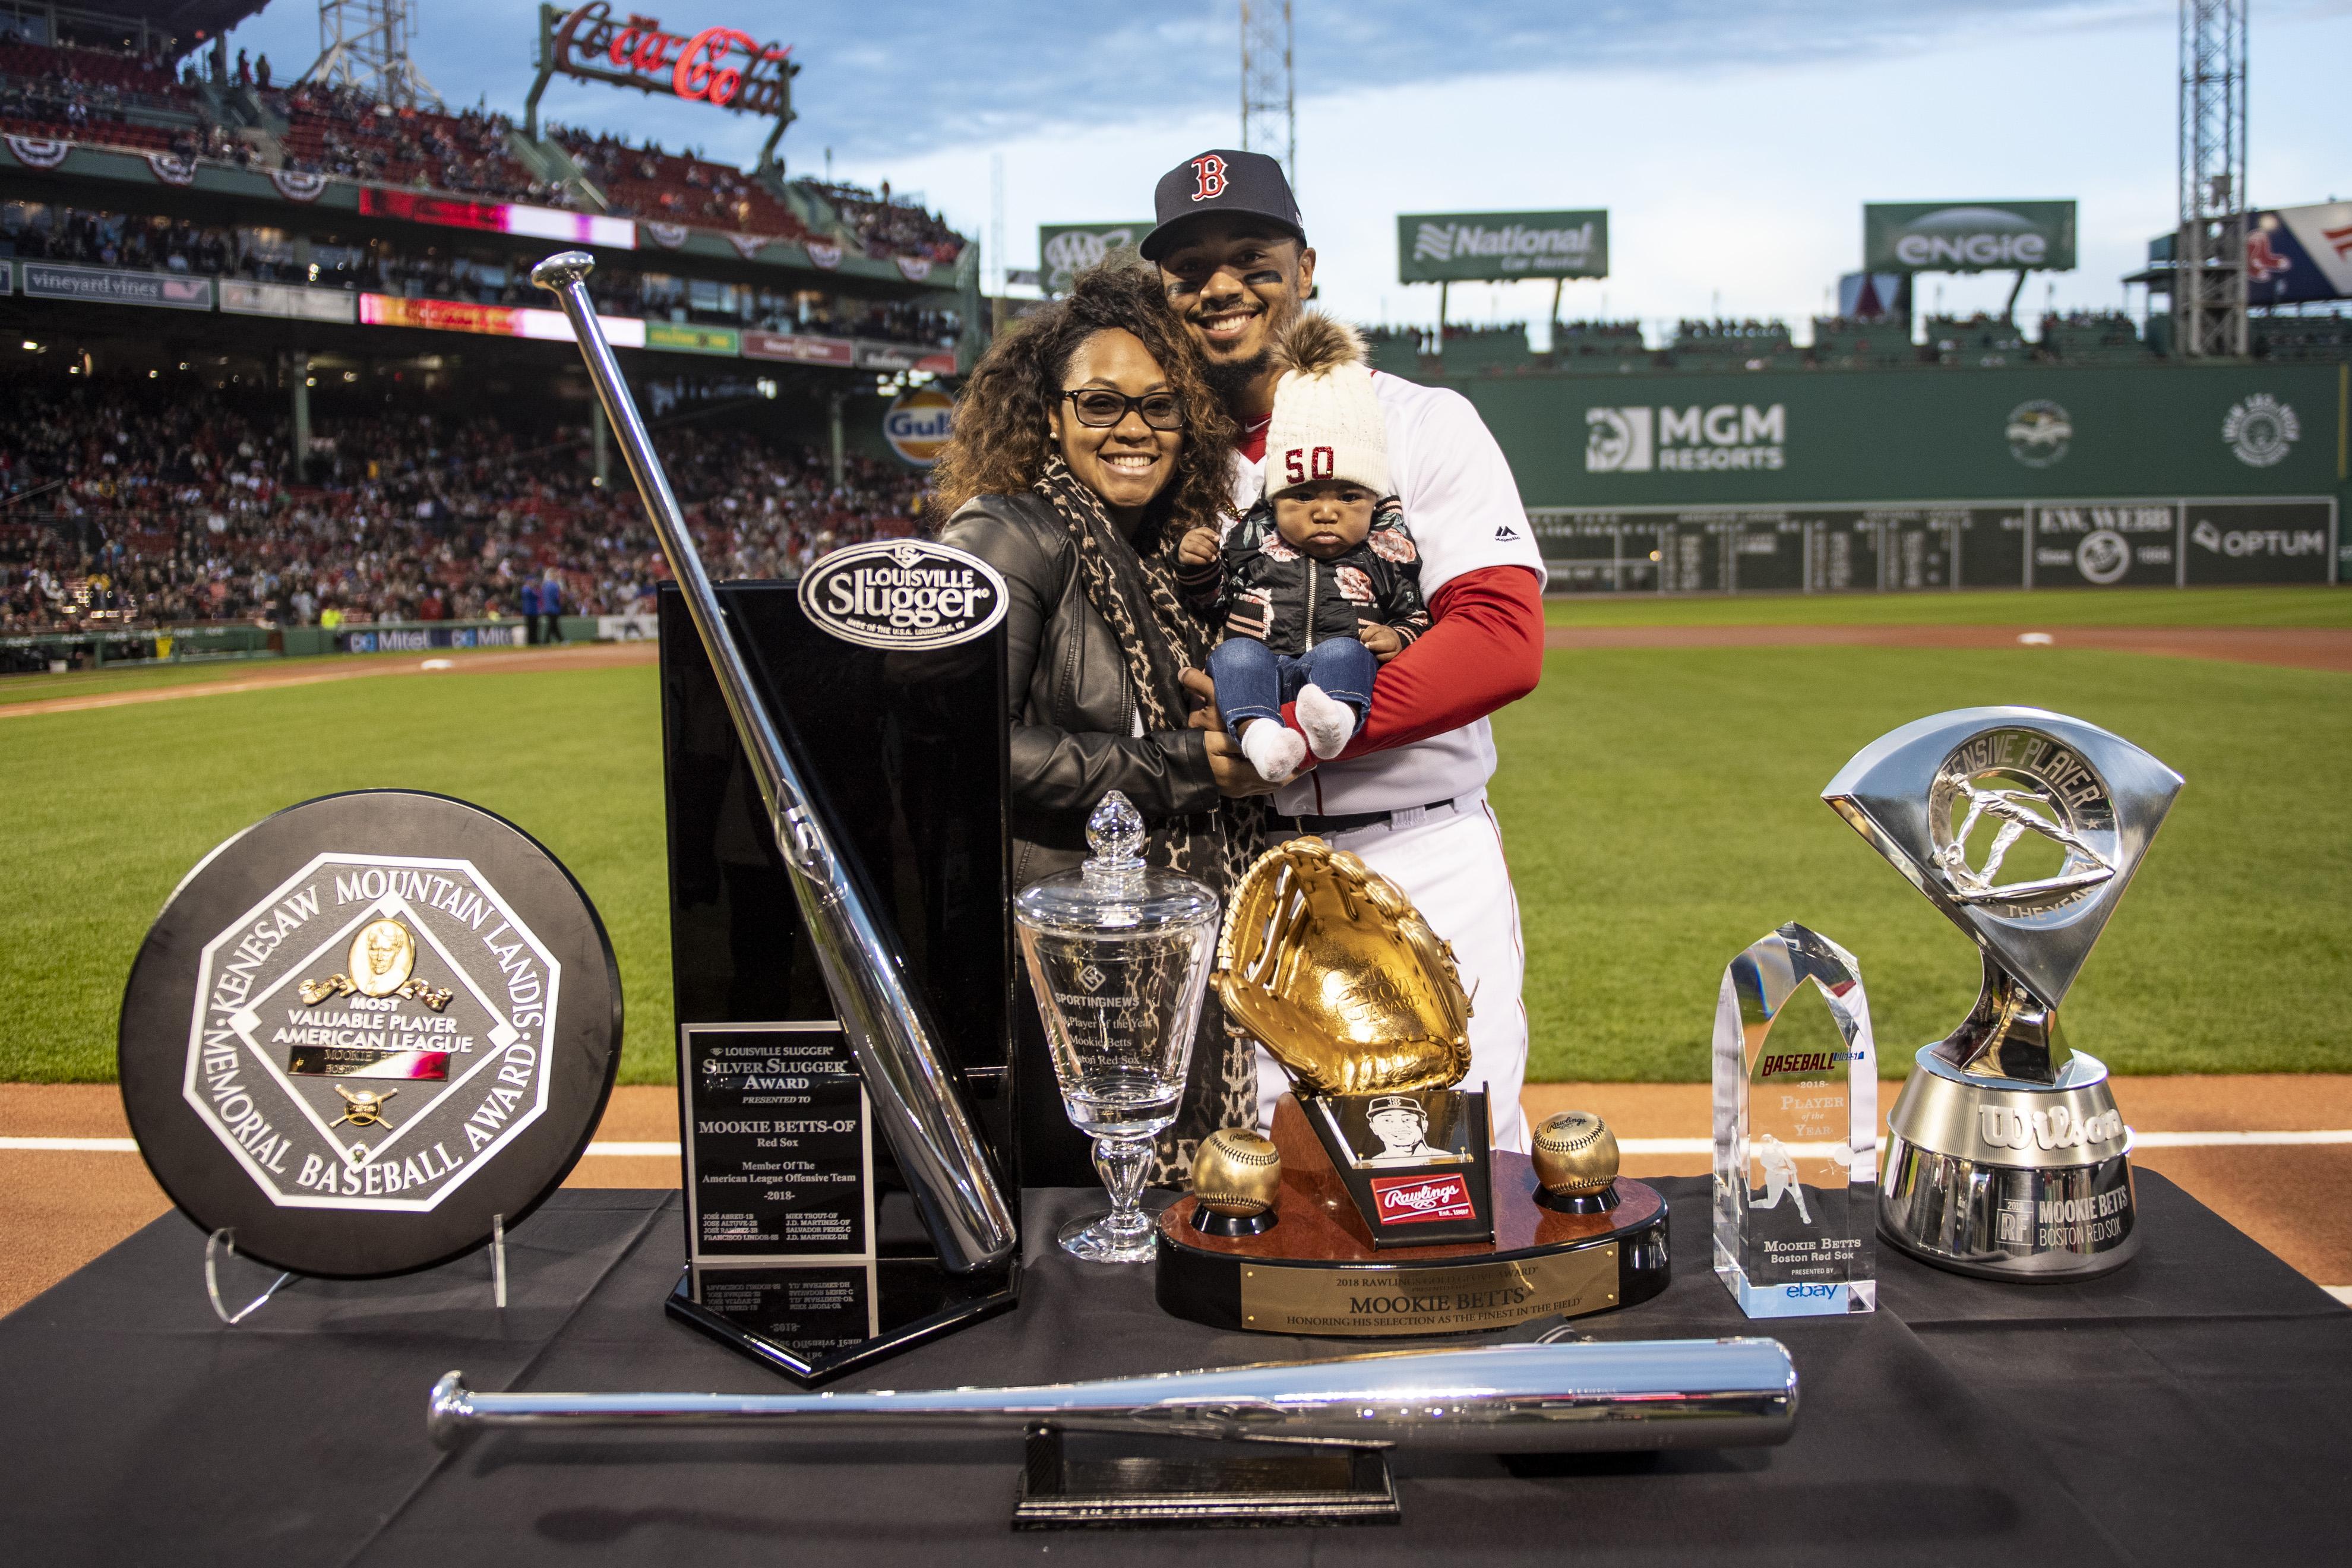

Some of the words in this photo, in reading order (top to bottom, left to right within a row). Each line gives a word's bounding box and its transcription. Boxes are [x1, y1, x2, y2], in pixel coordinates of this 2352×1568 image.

[1191, 154, 1228, 201] B
[1454, 222, 1594, 257] National
[32, 271, 109, 296] vineyard
[110, 277, 159, 296] vines
[889, 412, 952, 436] Gul
[1659, 404, 1785, 445] MGM
[1285, 446, 1333, 484] 50
[1659, 447, 1785, 470] RESORTS
[2223, 530, 2325, 556] OPTUM
[865, 567, 975, 588] LOUISVILLE
[828, 569, 982, 628] Slugger
[846, 617, 867, 631] MADE
[867, 624, 877, 632] IN
[378, 630, 431, 651] Mitel
[478, 627, 513, 647] Mit
[2019, 738, 2100, 808] PLAYER
[2006, 904, 2047, 921] THE
[210, 884, 321, 1015] KENESAW
[335, 869, 492, 931] MOUNTAIN
[482, 920, 543, 1029] LANDIS
[349, 997, 402, 1012] MOST
[287, 1009, 386, 1030] VALUABLE
[388, 1014, 459, 1034] PLAYER
[1070, 1017, 1097, 1030] Player
[1113, 1019, 1128, 1029] the
[271, 1026, 386, 1048] AMERICAN
[391, 1032, 475, 1054] LEAGUE
[1070, 1035, 1103, 1047] Mookie
[1108, 1038, 1132, 1047] Betts
[324, 1049, 374, 1061] MOOKIE
[725, 1047, 780, 1056] LOUISVILLE
[1099, 1056, 1118, 1065] Red
[1121, 1056, 1140, 1065] Sox
[703, 1058, 764, 1074] SILVER
[1761, 1052, 1835, 1077] BASEBALL
[742, 1074, 810, 1089] AWARD
[1797, 1080, 1829, 1089] -2018-
[204, 1028, 286, 1175] MEMORIAL
[296, 1140, 464, 1196] BASEBALL
[462, 1042, 538, 1154] AWARD
[1781, 1096, 1844, 1111] PLAYER
[698, 1121, 771, 1133] MOOKIE
[773, 1120, 856, 1133] BETTS-OF
[1546, 1117, 1587, 1133] Rawlings
[1801, 1112, 1810, 1122] of
[1811, 1111, 1825, 1120] the
[1794, 1124, 1831, 1136] YEAR
[1979, 1104, 2125, 1150] Wilson
[757, 1138, 777, 1147] Red
[780, 1138, 798, 1147] Sox
[742, 1162, 780, 1170] Member
[782, 1161, 796, 1170] Of
[797, 1162, 815, 1170] The
[702, 1175, 747, 1183] American
[750, 1174, 783, 1185] League
[785, 1174, 829, 1183] Offensive
[830, 1174, 856, 1182] Team
[764, 1191, 795, 1200] -2018-
[1384, 1184, 1459, 1208] Rawlings
[2039, 1196, 2098, 1224] MOOKIE
[2098, 1186, 2127, 1213] BETTS
[2000, 1212, 2027, 1241] RF
[2039, 1228, 2085, 1246] BOSTON
[2087, 1225, 2104, 1243] RED
[2106, 1219, 2122, 1239] SOX
[1763, 1240, 1816, 1253] MOOKIE
[1821, 1238, 1861, 1250] BETTS
[1771, 1254, 1808, 1263] Boston
[1811, 1251, 1831, 1262] Red
[1834, 1251, 1854, 1260] Sox
[1336, 1278, 1360, 1287] 2018
[1362, 1278, 1421, 1287] RAWLINGS
[1786, 1282, 1838, 1300] ebay
[1349, 1295, 1450, 1314] MOOKIE
[1456, 1287, 1525, 1310] BETTS
[1287, 1316, 1350, 1326] HONORING
[1353, 1317, 1371, 1326] HIS
[1373, 1316, 1435, 1326] SELECTION
[1437, 1315, 1451, 1324] AS
[1453, 1314, 1476, 1323] THE
[1478, 1309, 1515, 1322] FINEST
[1517, 1307, 1528, 1316] IN
[1530, 1304, 1551, 1314] THE
[1553, 1298, 1580, 1310] FIELD
